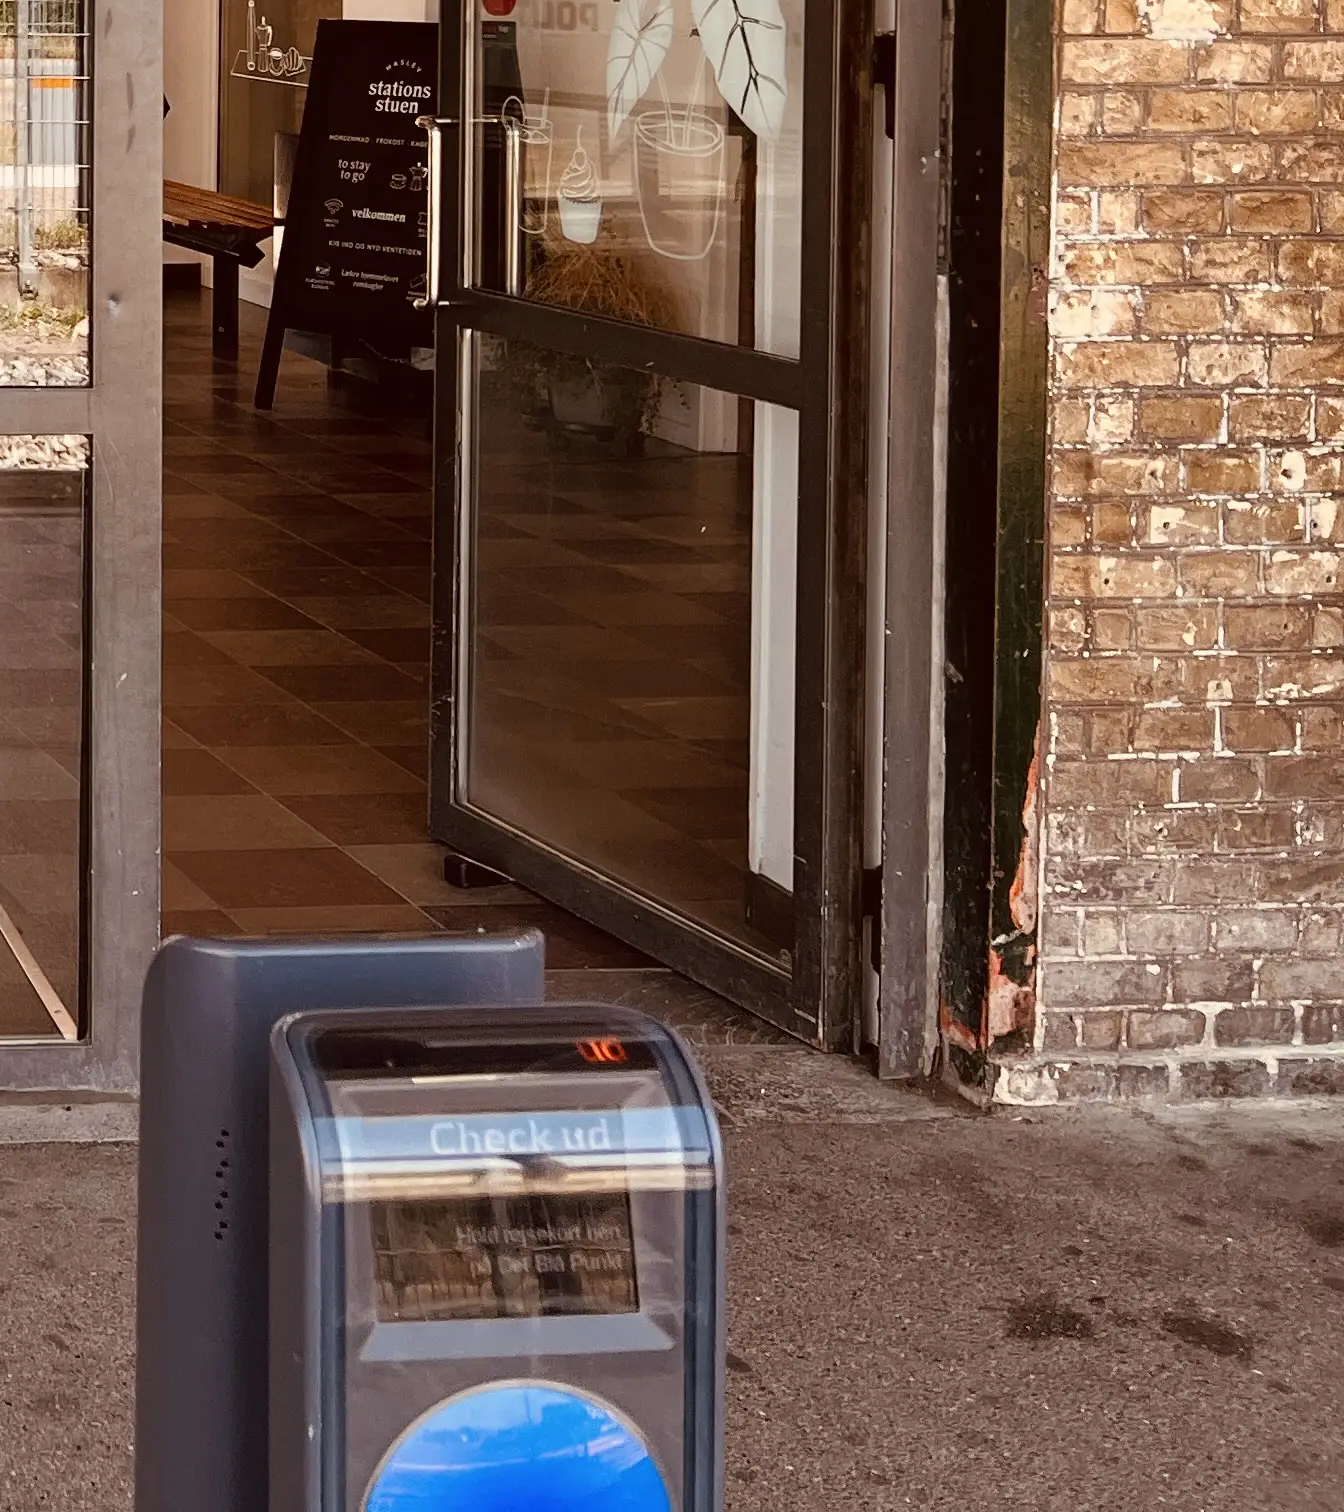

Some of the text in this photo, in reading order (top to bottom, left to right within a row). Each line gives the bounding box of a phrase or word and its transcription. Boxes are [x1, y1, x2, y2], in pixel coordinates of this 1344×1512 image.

[368, 80, 432, 99] stations
[374, 97, 419, 114] stuen
[375, 137, 405, 146] FROKOST
[338, 159, 371, 173] to stay
[340, 169, 366, 183] to go
[351, 208, 406, 223] velkommen
[428, 1118, 612, 1155] Check ud
